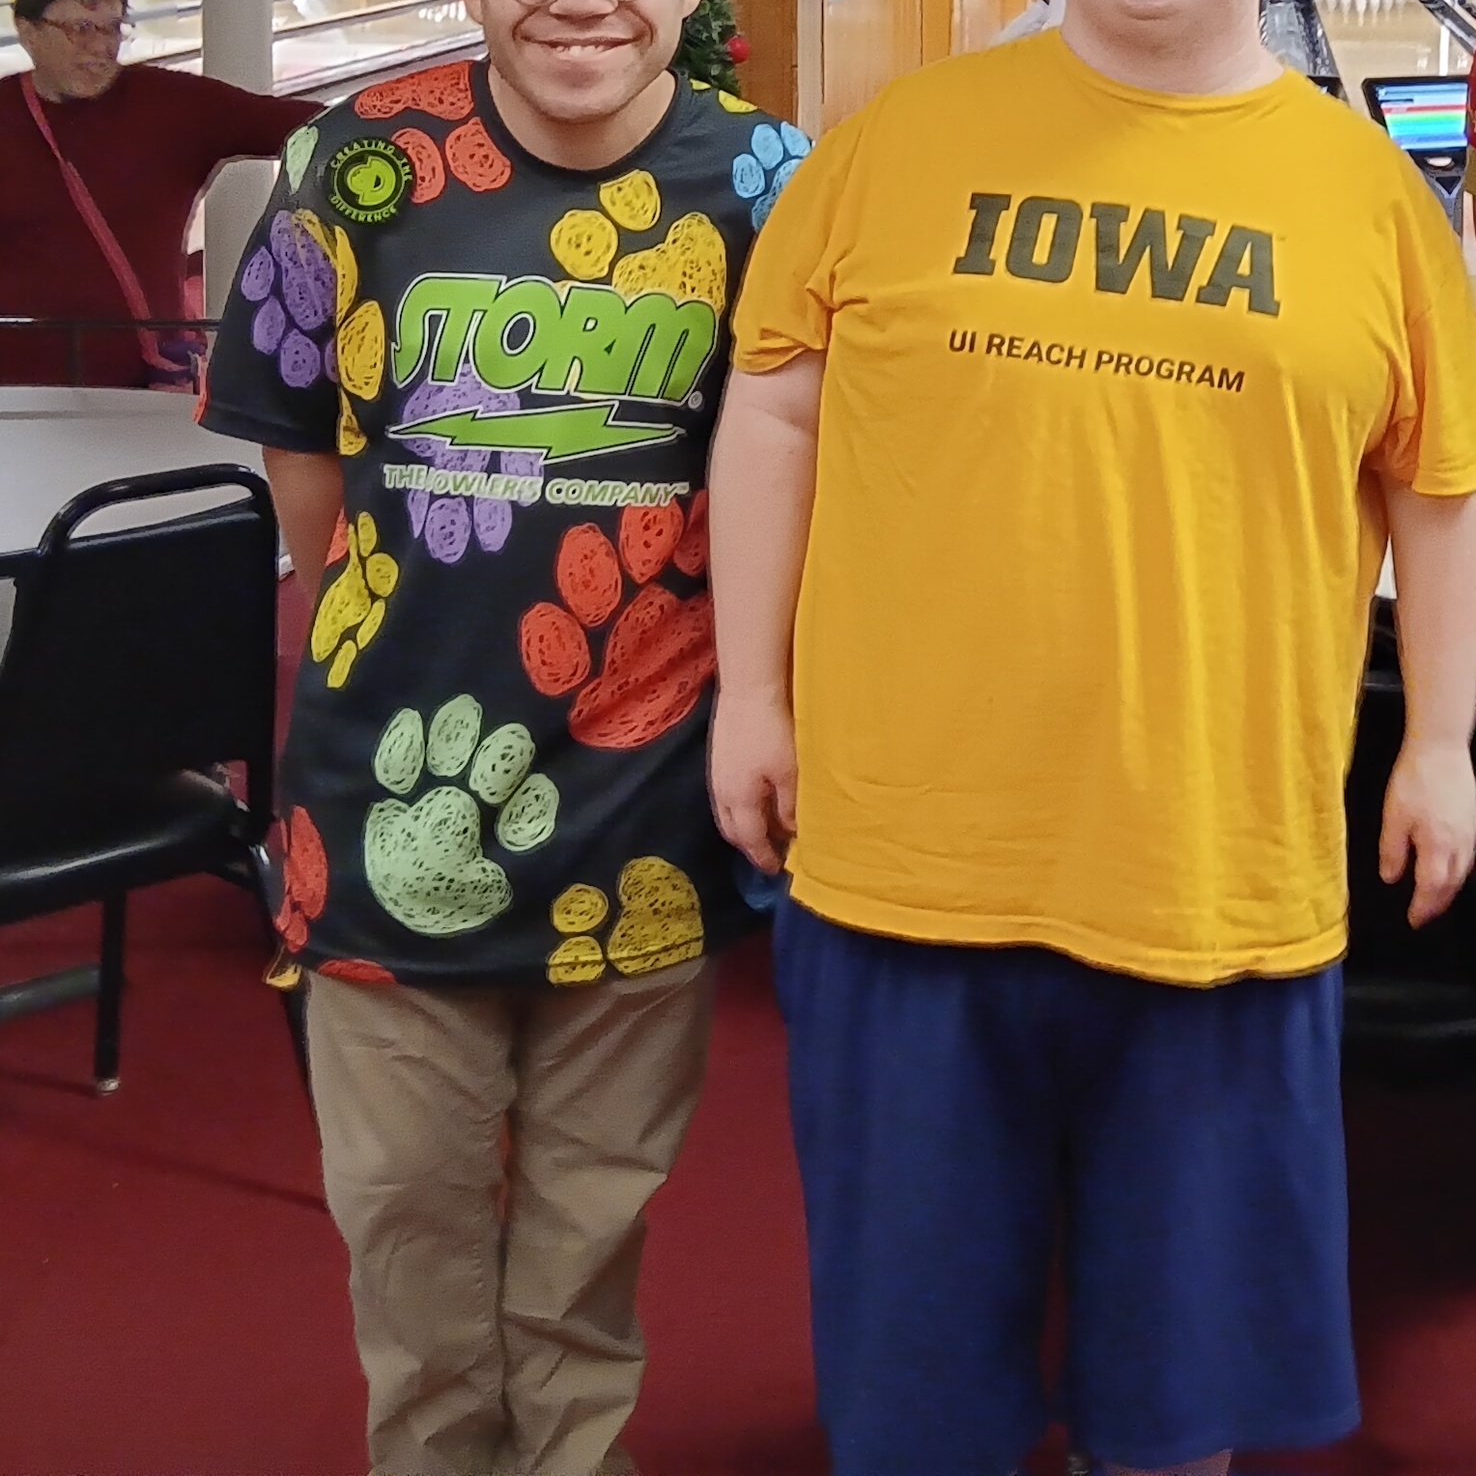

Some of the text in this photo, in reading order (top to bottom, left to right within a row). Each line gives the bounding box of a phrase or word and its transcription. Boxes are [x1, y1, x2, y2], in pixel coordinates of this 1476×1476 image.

[330, 139, 396, 169] CREATING
[329, 194, 397, 223] DIFFERENCE
[952, 193, 1281, 318] IOWA
[393, 273, 718, 405] STORM
[949, 329, 1246, 393] UI REACH PROGRAM
[384, 464, 681, 507] THE OWLER'S COMPANY
